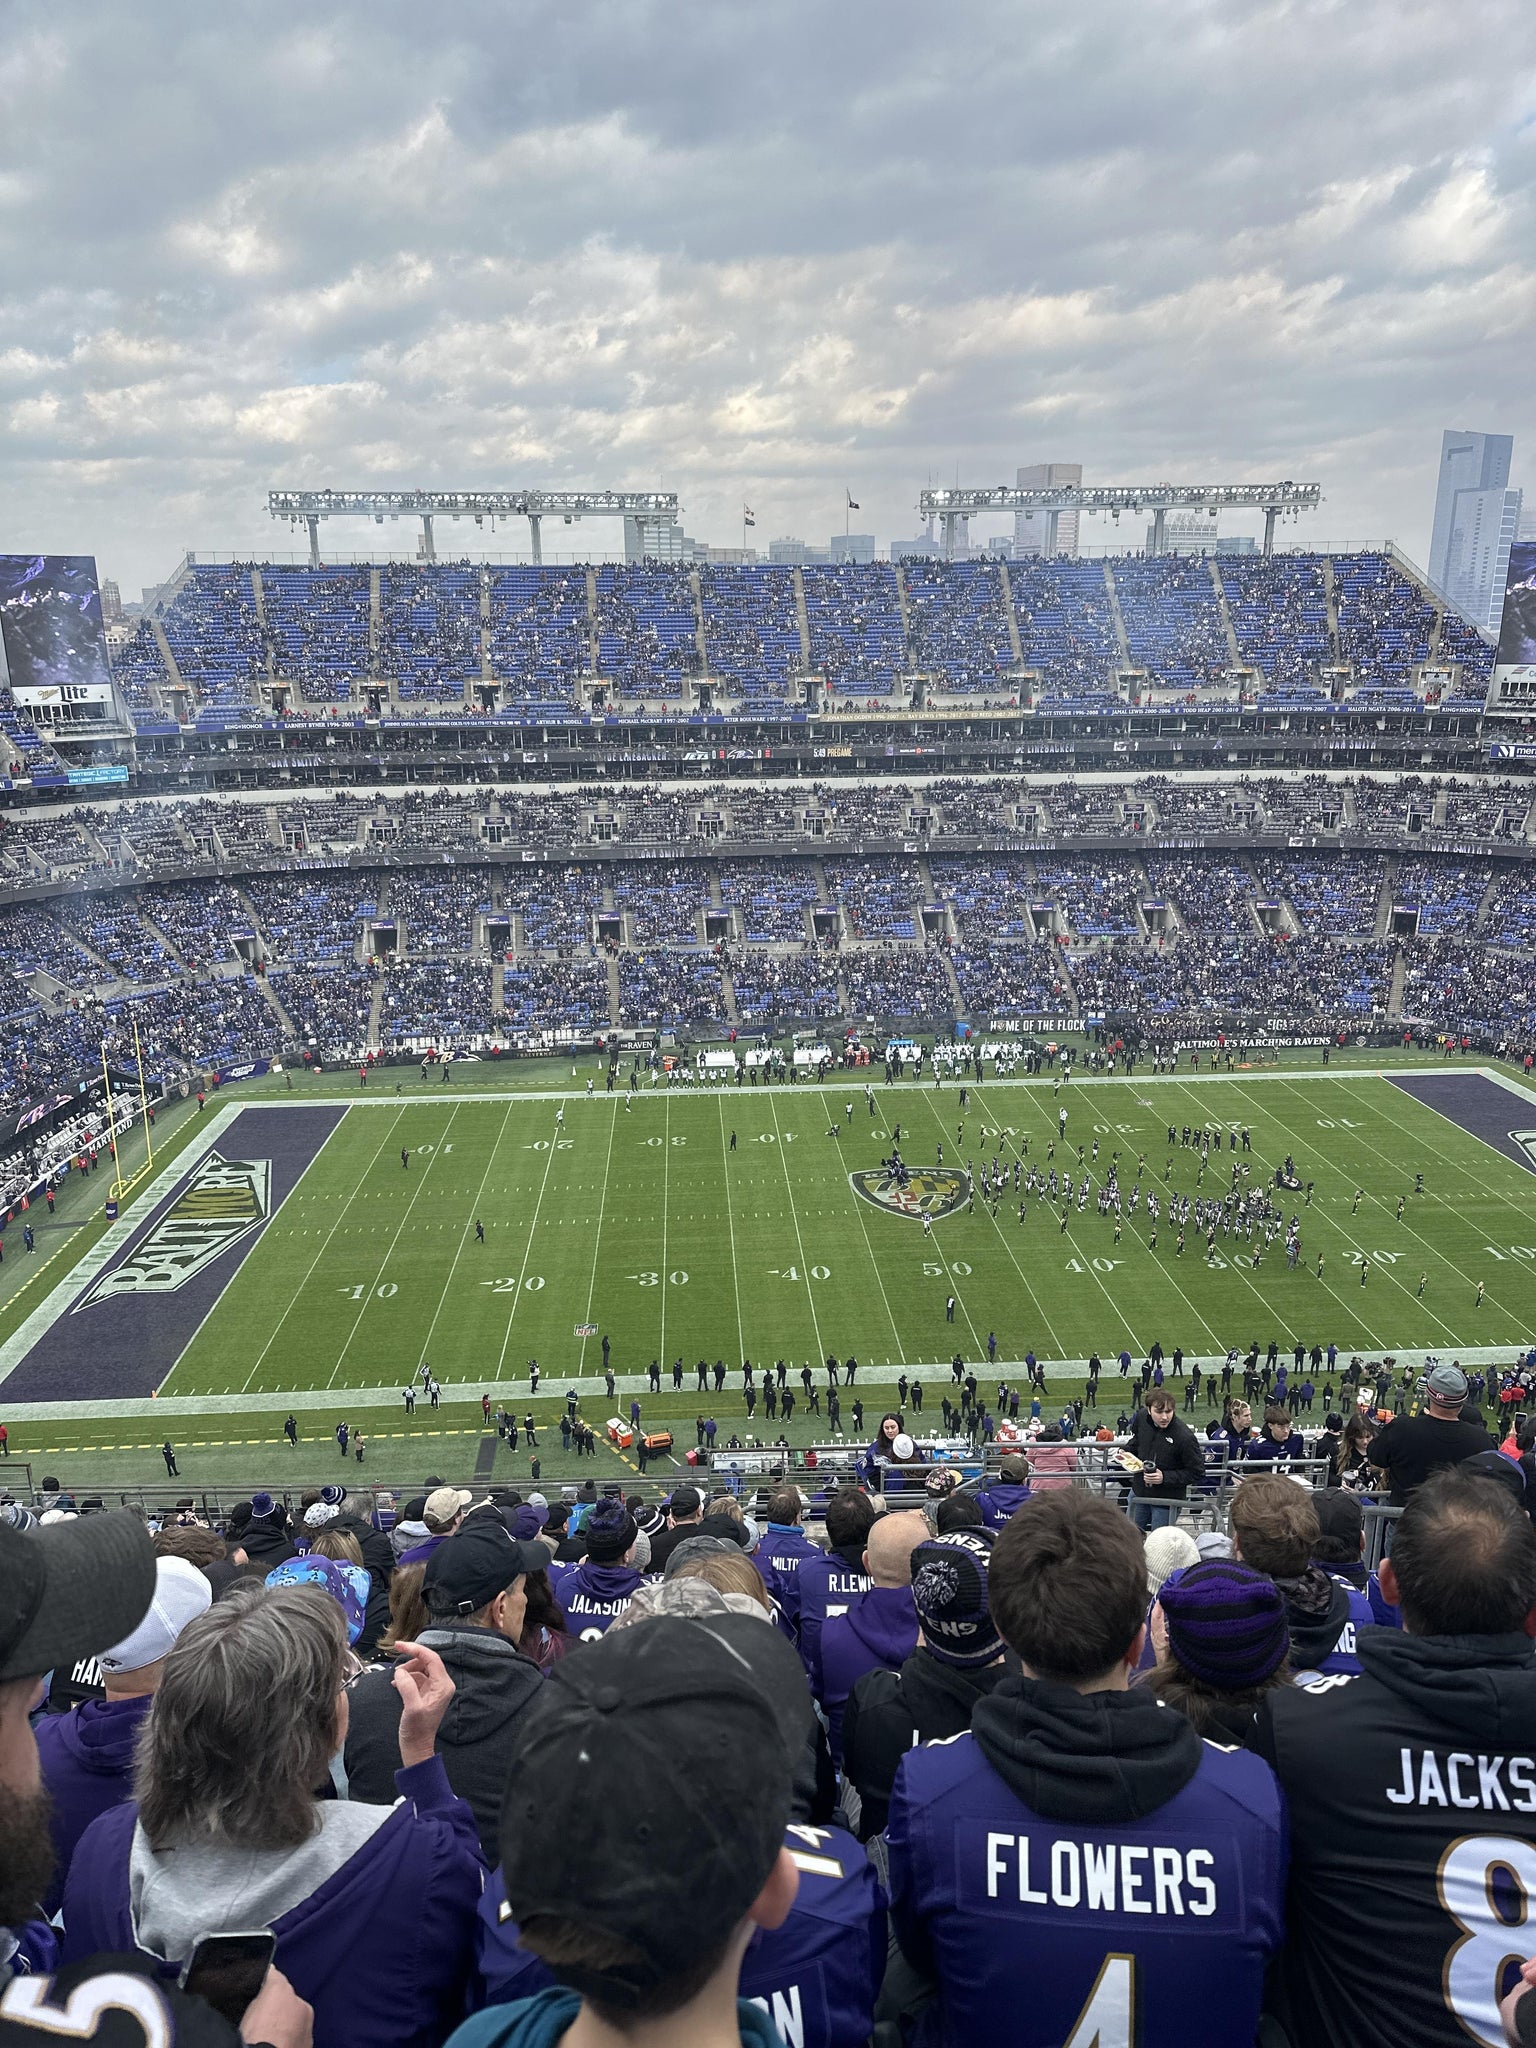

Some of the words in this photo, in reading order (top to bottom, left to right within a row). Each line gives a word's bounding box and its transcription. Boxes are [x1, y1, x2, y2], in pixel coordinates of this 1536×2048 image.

[60, 685, 88, 703] Lite
[683, 749, 709, 760] JETS
[826, 746, 853, 758] PREGAME
[1022, 1019, 1035, 1031] OF
[1037, 1019, 1055, 1031] THE
[1057, 1019, 1086, 1031] FLOCK
[628, 1040, 653, 1050] RAVEN
[1239, 1036, 1293, 1047] MARCHING
[1294, 1036, 1331, 1046] RAVENS
[88, 1118, 133, 1155] MARYAND
[86, 1157, 267, 1302] BALTIMORE
[986, 1831, 1217, 1917] FLOWERS
[1436, 1832, 1536, 2048] 8
